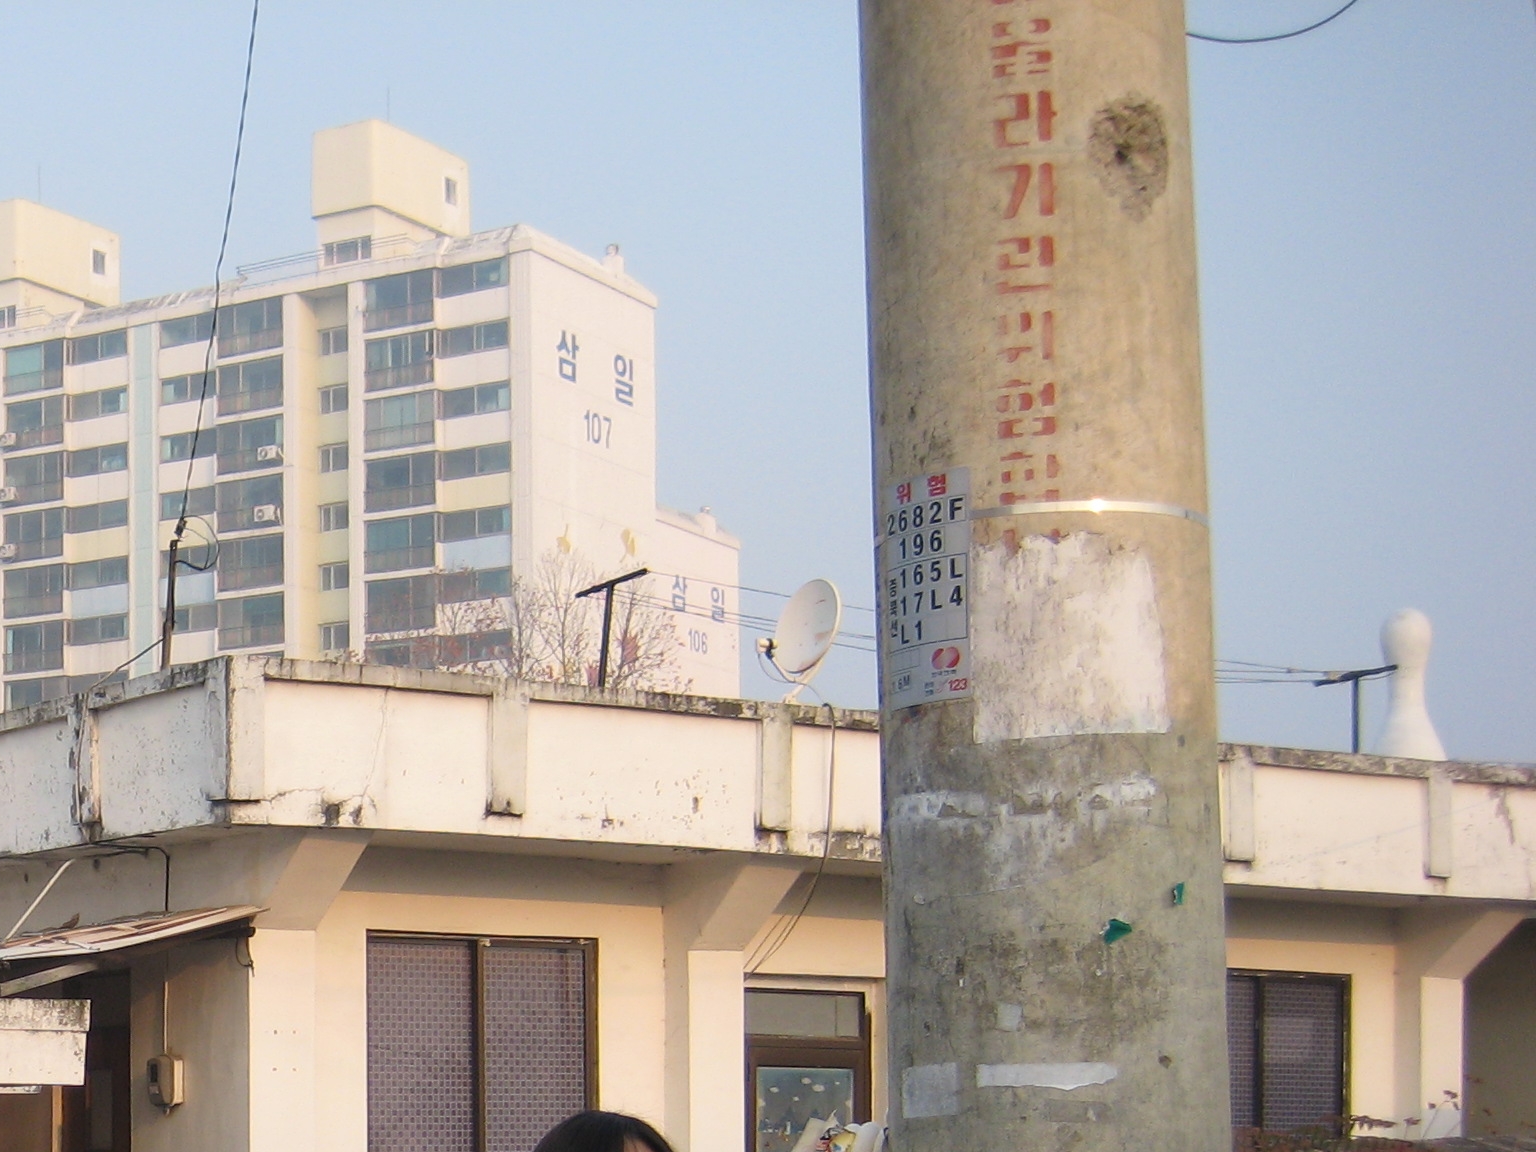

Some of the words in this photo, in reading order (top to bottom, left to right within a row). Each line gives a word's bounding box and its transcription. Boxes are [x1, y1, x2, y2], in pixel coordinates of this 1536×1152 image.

[556, 329, 634, 407] 삼일
[583, 409, 612, 449] 107
[887, 497, 964, 536] 2682F
[899, 529, 942, 559] 196
[900, 558, 963, 589] 165L
[672, 575, 724, 623] 삼일
[900, 585, 963, 616] 17L4
[688, 628, 708, 654] 106
[901, 620, 922, 645] L1
[948, 678, 968, 692] 123
